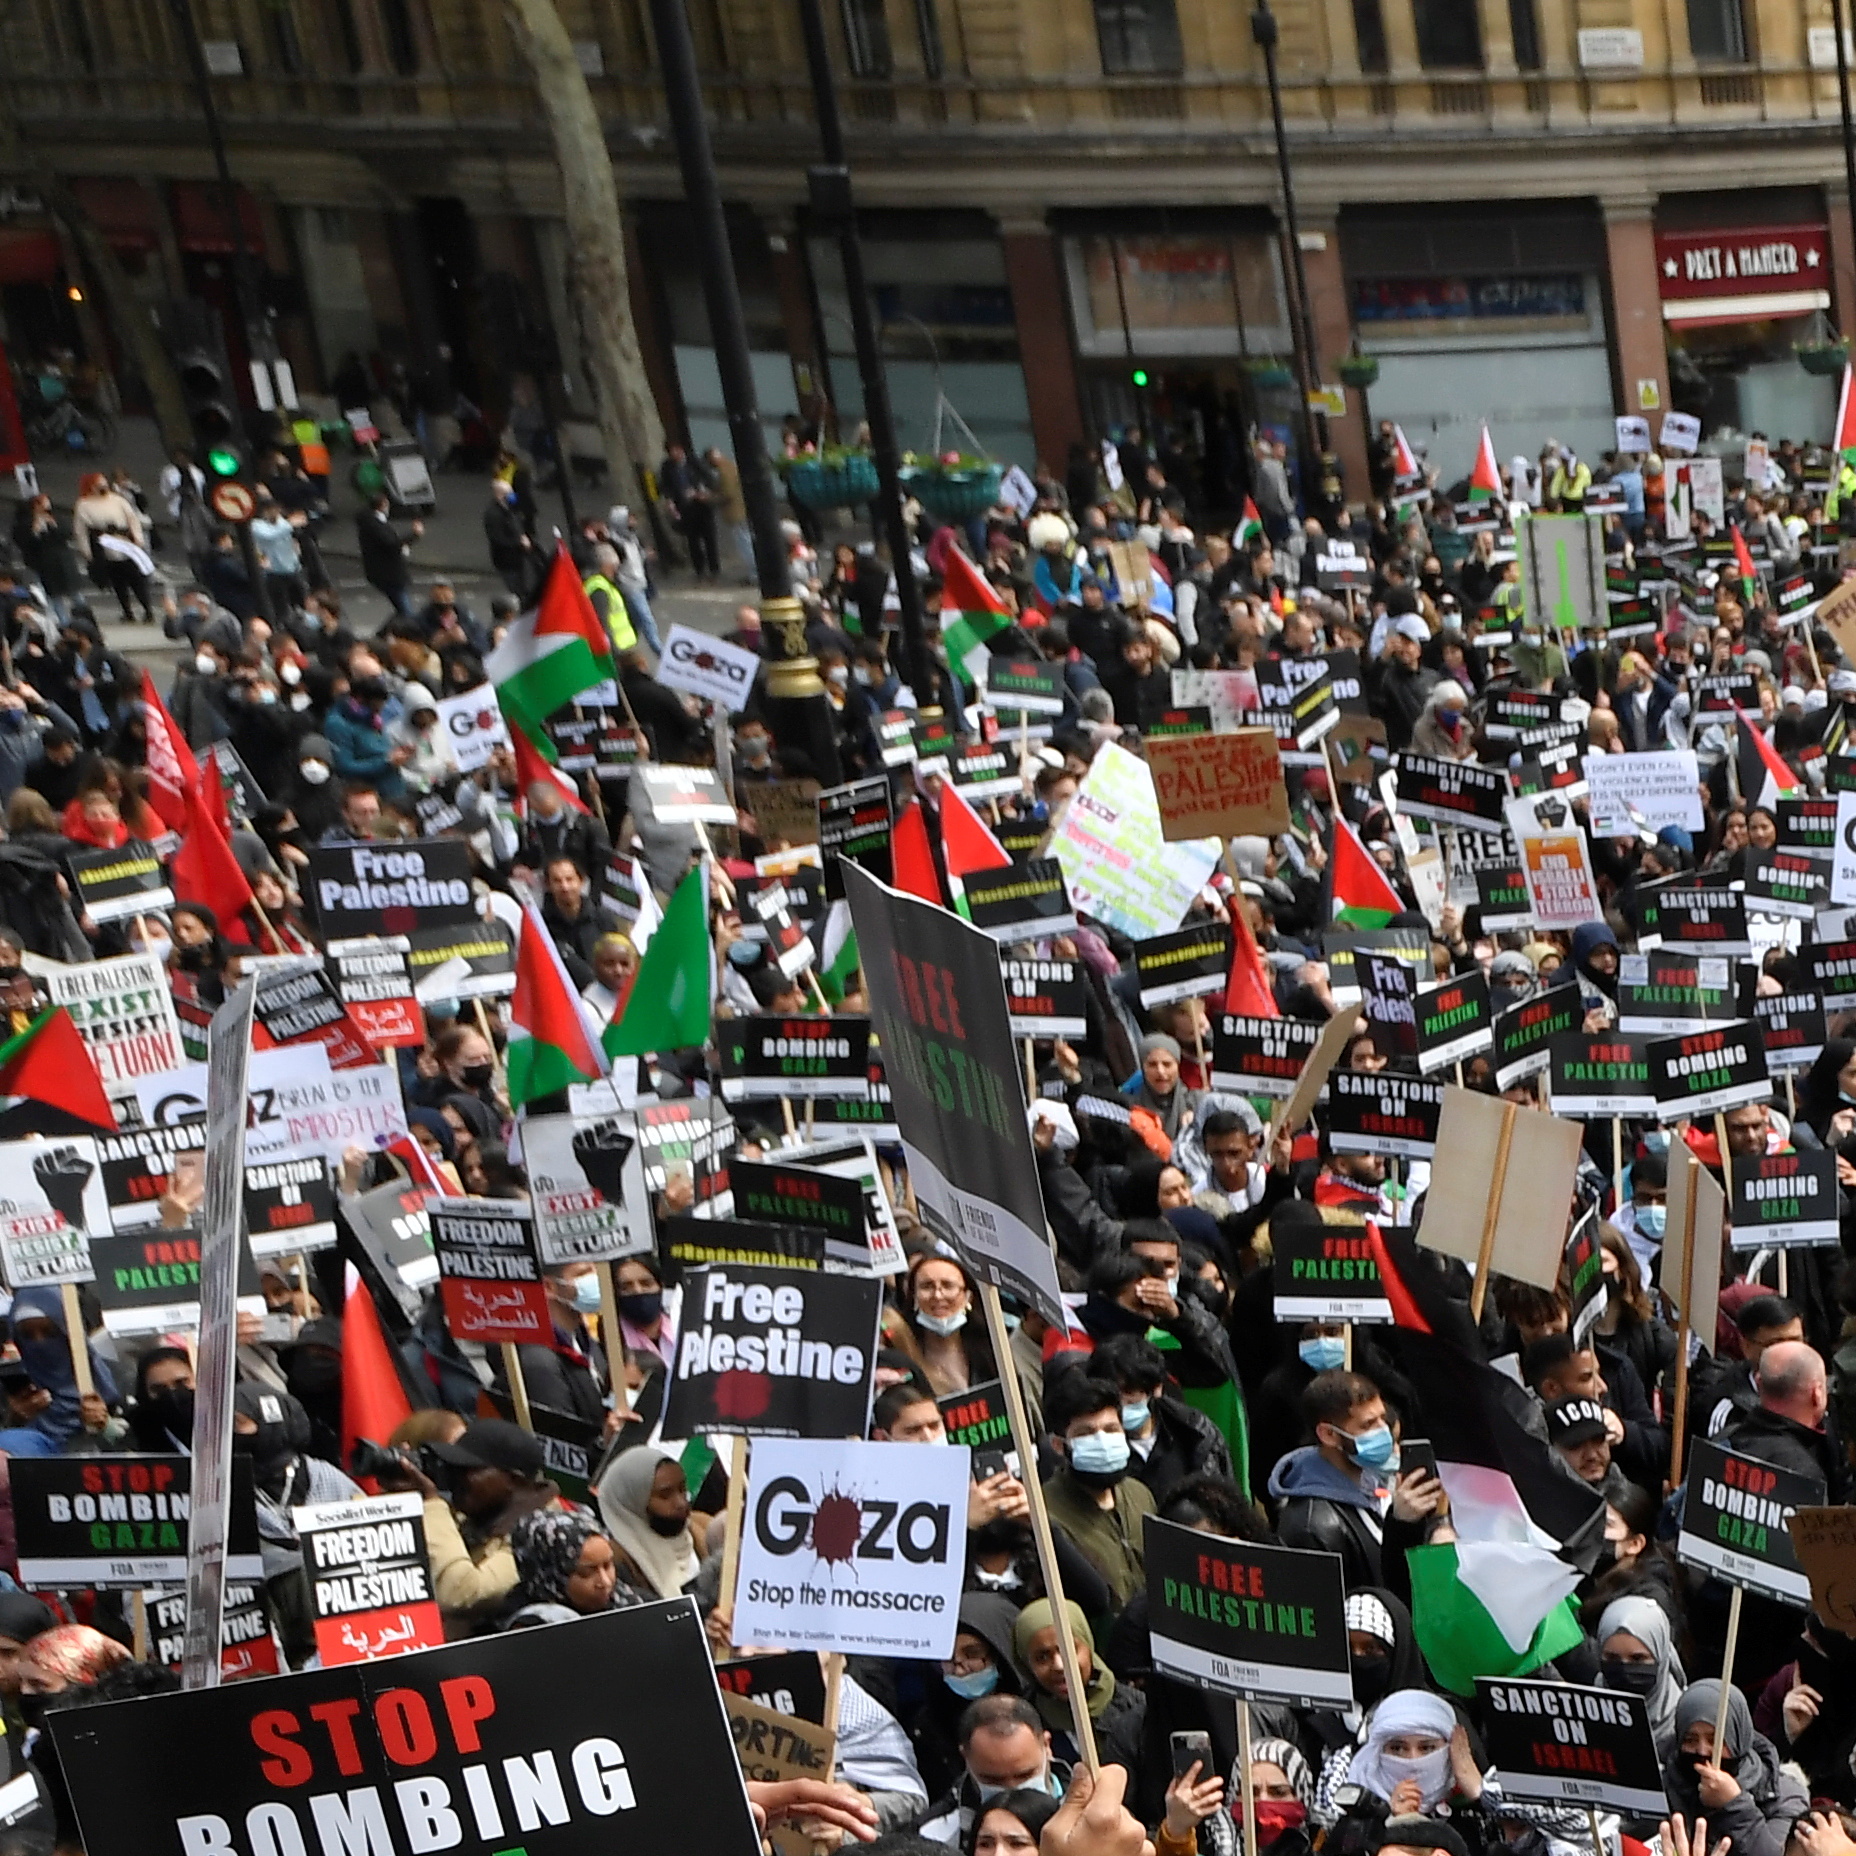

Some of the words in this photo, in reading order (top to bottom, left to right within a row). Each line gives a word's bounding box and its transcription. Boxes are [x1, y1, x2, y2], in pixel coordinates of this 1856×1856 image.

[1685, 247, 1720, 280] PRET
[1726, 250, 1736, 278] A
[1739, 243, 1799, 277] MANGER
[352, 850, 425, 881] Free
[319, 877, 469, 911] Palestine
[437, 1215, 524, 1248] FREEDOM
[440, 1252, 536, 1280] PALESTINE
[704, 1273, 803, 1325] Free
[679, 1324, 864, 1384] Plestine
[82, 1466, 173, 1494] STOP
[1724, 1459, 1776, 1493] STOP
[49, 1494, 191, 1522] BOMBIN
[755, 1475, 949, 1564] Gza
[91, 1522, 180, 1550] GAZA
[313, 1523, 415, 1567] FREEDOM
[1716, 1519, 1768, 1554] GAZA
[1198, 1554, 1264, 1598] FREE
[316, 1574, 428, 1616] PALESTINE
[748, 1579, 794, 1608] Stop
[800, 1582, 826, 1605] the
[831, 1588, 945, 1613] massacre
[1164, 1578, 1318, 1638] PALESTINE
[1490, 1686, 1633, 1727] SANCTIONS
[251, 1675, 496, 1787] STOP
[1553, 1718, 1587, 1746] ON
[1533, 1746, 1616, 1775] ISRAEL
